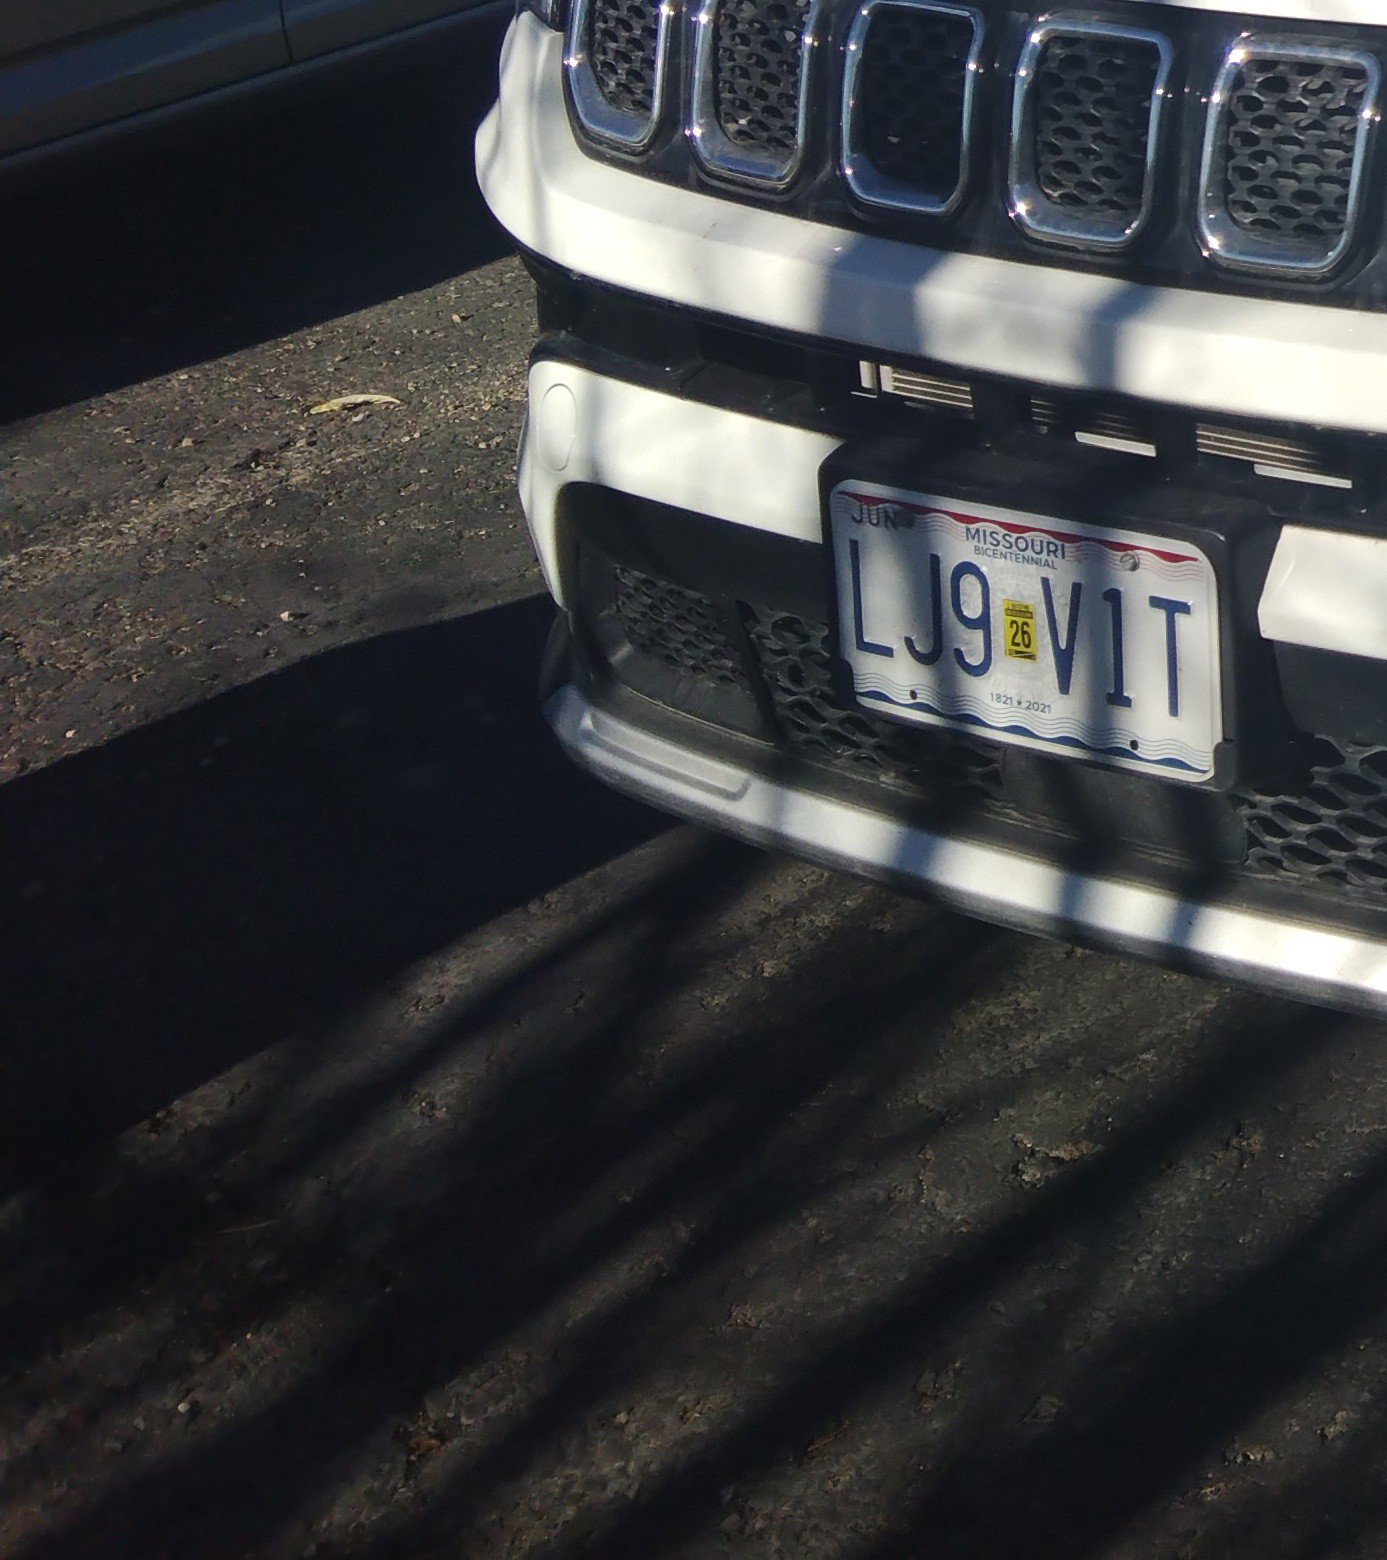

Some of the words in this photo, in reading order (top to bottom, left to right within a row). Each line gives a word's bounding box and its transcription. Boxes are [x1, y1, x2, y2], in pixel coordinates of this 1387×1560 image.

[964, 526, 1066, 559] MISSOURI
[973, 544, 1058, 570] BICENTENNIAL
[849, 539, 993, 678] LJ9
[1041, 576, 1193, 718] V1T
[1009, 619, 1032, 649] 26
[990, 692, 1013, 707] 1821
[1025, 700, 1052, 714] 2021
